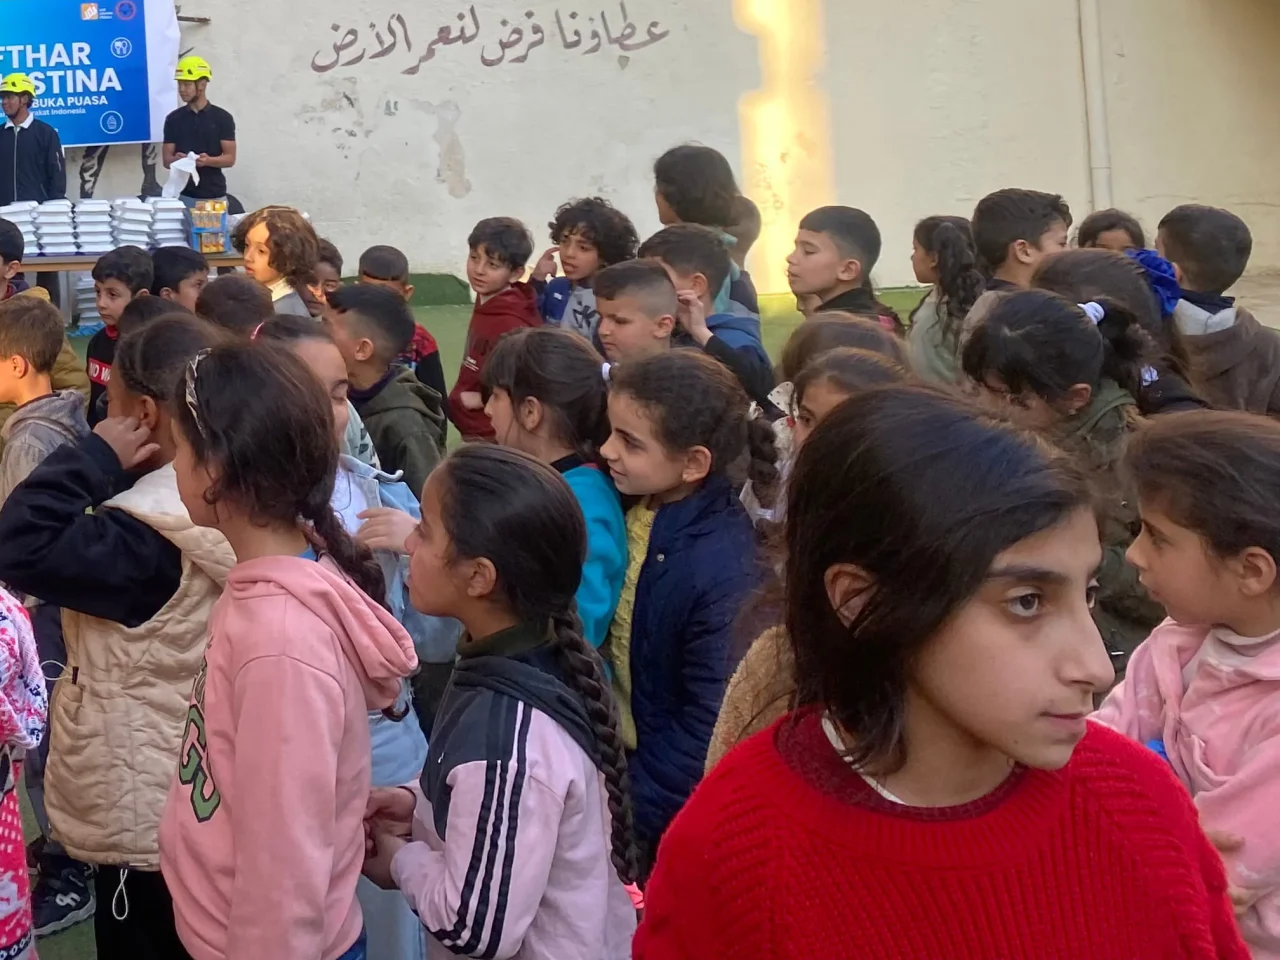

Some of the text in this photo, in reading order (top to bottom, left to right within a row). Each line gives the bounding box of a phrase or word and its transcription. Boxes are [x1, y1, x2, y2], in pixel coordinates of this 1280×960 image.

[480, 9, 545, 67] فرض
[67, 95, 109, 106] PUASA
[51, 107, 86, 115] Indonesia
